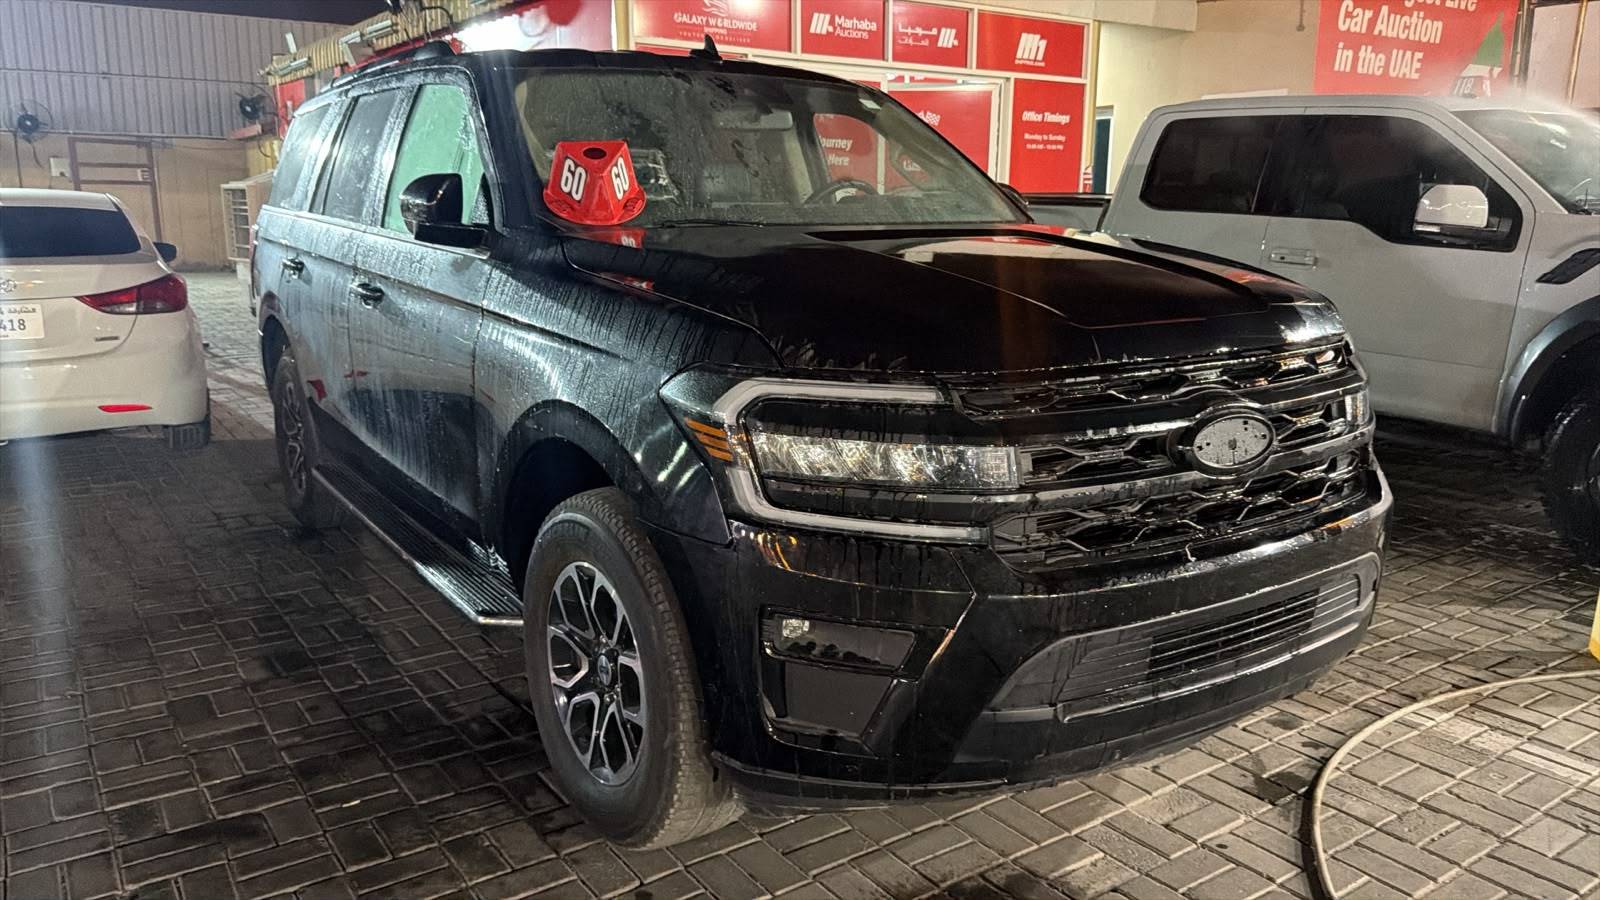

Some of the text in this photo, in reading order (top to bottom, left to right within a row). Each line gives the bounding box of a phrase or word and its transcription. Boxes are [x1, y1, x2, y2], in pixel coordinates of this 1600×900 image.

[673, 12, 708, 26] GALAXY
[834, 15, 877, 31] Marhaba
[1337, 0, 1444, 44] Car Auction
[834, 28, 869, 40] Auctions
[1334, 42, 1424, 79] in the UAE
[1022, 111, 1071, 125] Office Timings
[819, 137, 853, 151] ourney
[560, 158, 587, 201] 60
[611, 157, 630, 200] 60
